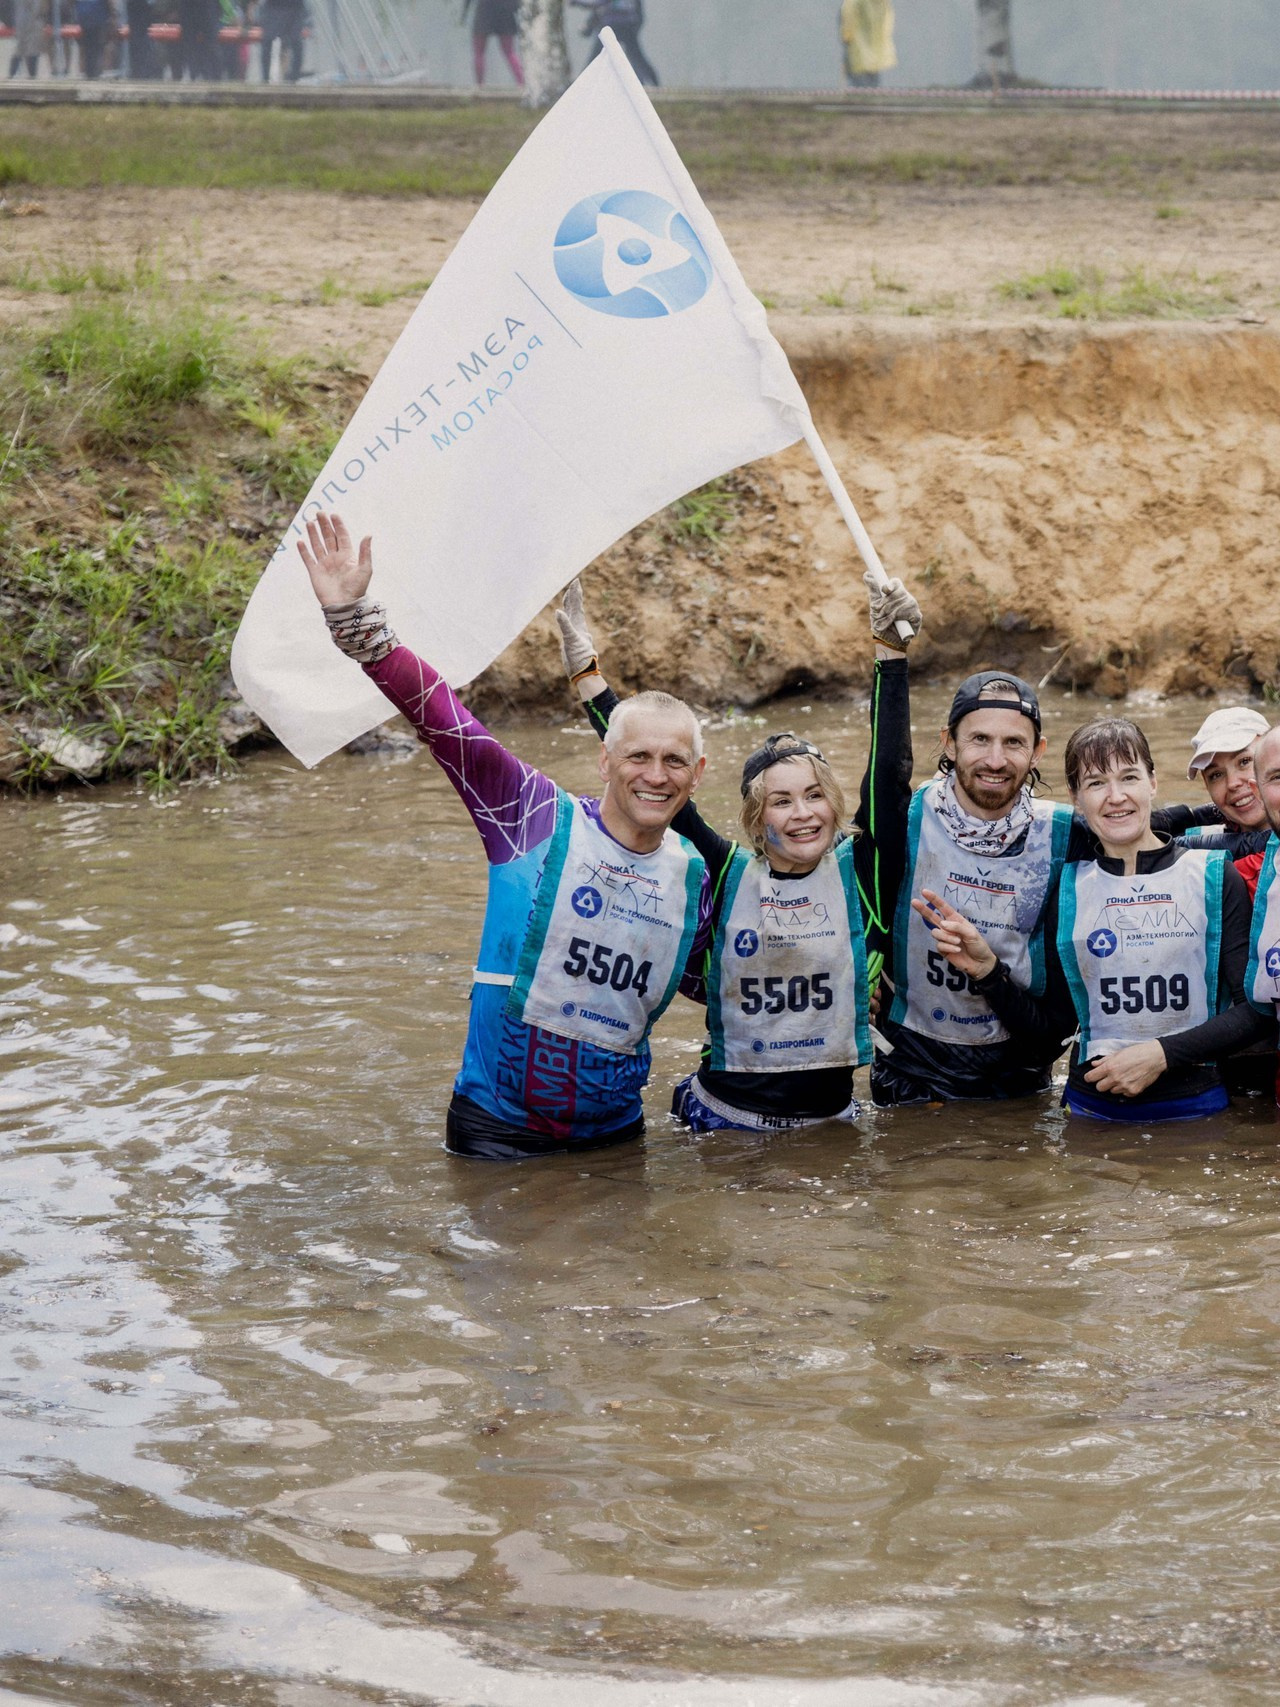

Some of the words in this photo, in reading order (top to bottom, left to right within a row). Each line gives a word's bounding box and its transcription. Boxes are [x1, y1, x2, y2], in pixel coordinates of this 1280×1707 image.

[583, 862, 664, 913] ЖЕКА
[949, 871, 980, 887] ГОНКА
[981, 879, 1015, 892] ГЕРОЕВ
[776, 896, 810, 907] ГЕРОЕВ
[1106, 897, 1135, 905] ГОНКА
[1137, 893, 1172, 902] ГЕРОЕВ
[609, 911, 634, 925] РОСАТОМ
[611, 904, 673, 929] АЭМ-ТЕХНОЛОГИИ
[767, 930, 836, 942] АЭМ-ТЕХНОЛОГИИ
[1126, 932, 1195, 940] АЭМ-ТЕХНОЛОГИИ
[563, 936, 653, 998] 5504
[740, 972, 833, 1015] 5505
[1100, 973, 1189, 1015] 5509
[579, 1009, 630, 1031] ГАЗПРОМБАНК
[769, 1037, 826, 1050] ГАЗПРОМБАНК
